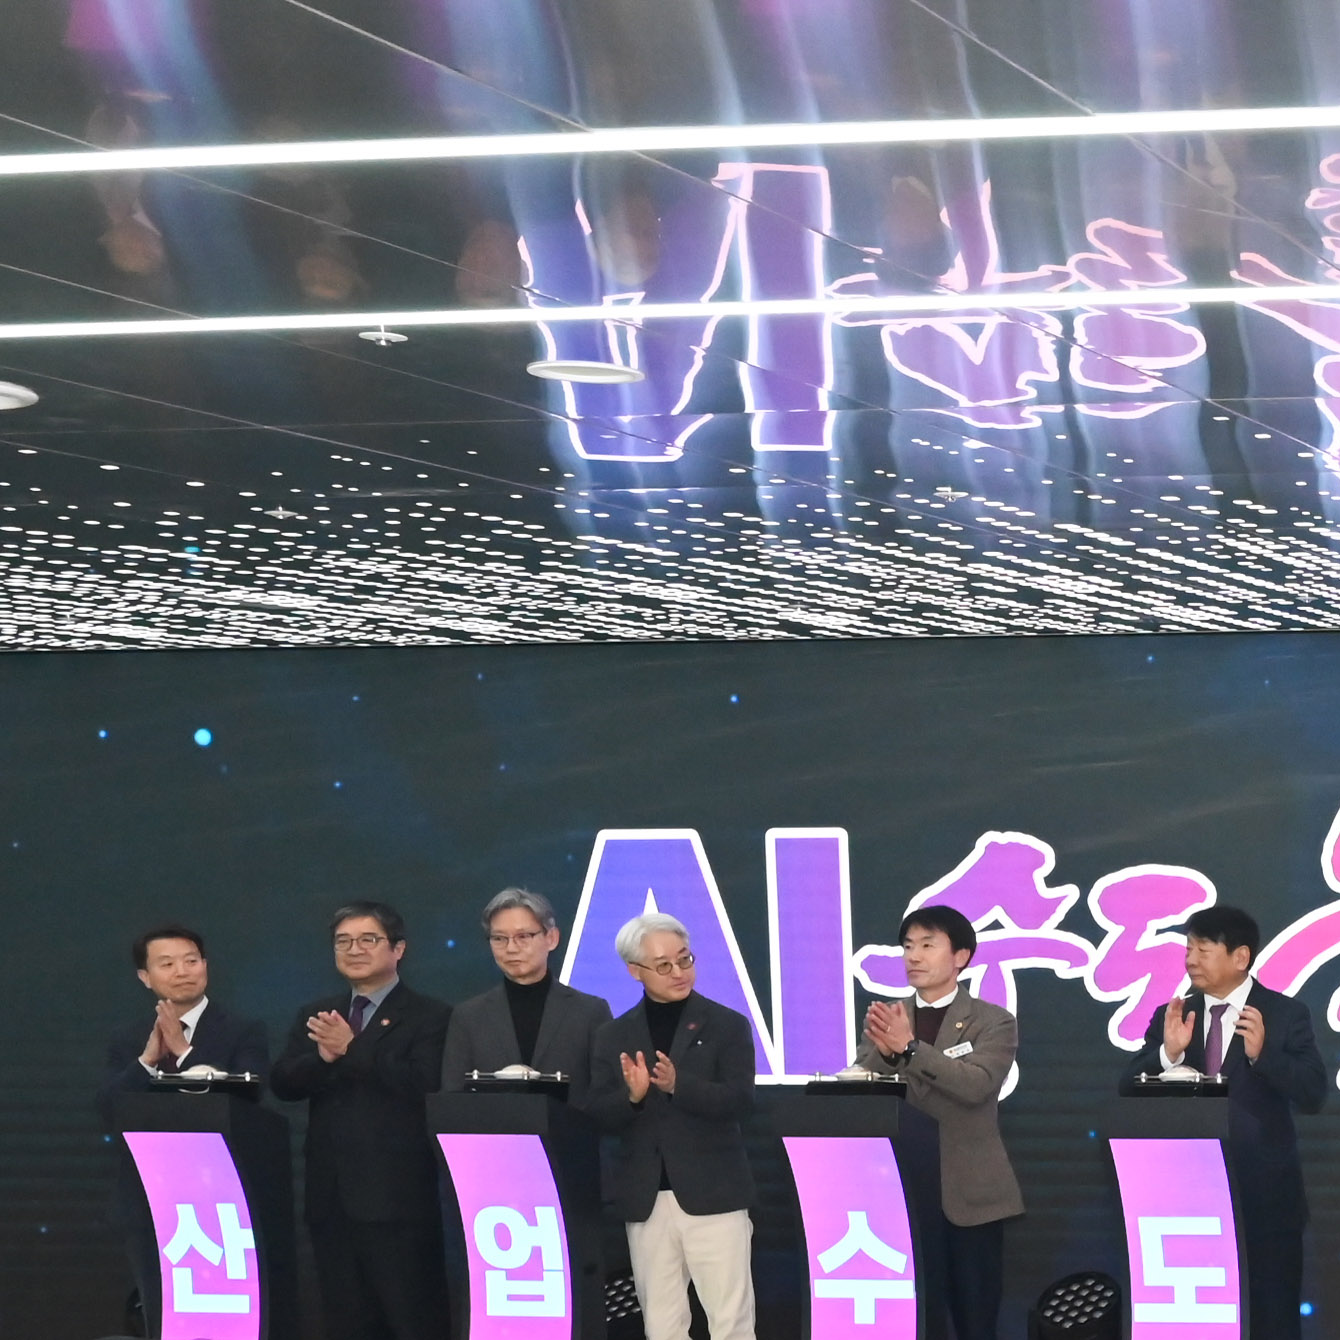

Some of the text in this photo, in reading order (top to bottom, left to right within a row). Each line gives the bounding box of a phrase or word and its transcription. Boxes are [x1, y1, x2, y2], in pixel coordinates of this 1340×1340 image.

[162, 1202, 257, 1315] 산
[473, 1204, 566, 1318] 업
[813, 1210, 914, 1325] 수
[1133, 1215, 1238, 1323] 도
